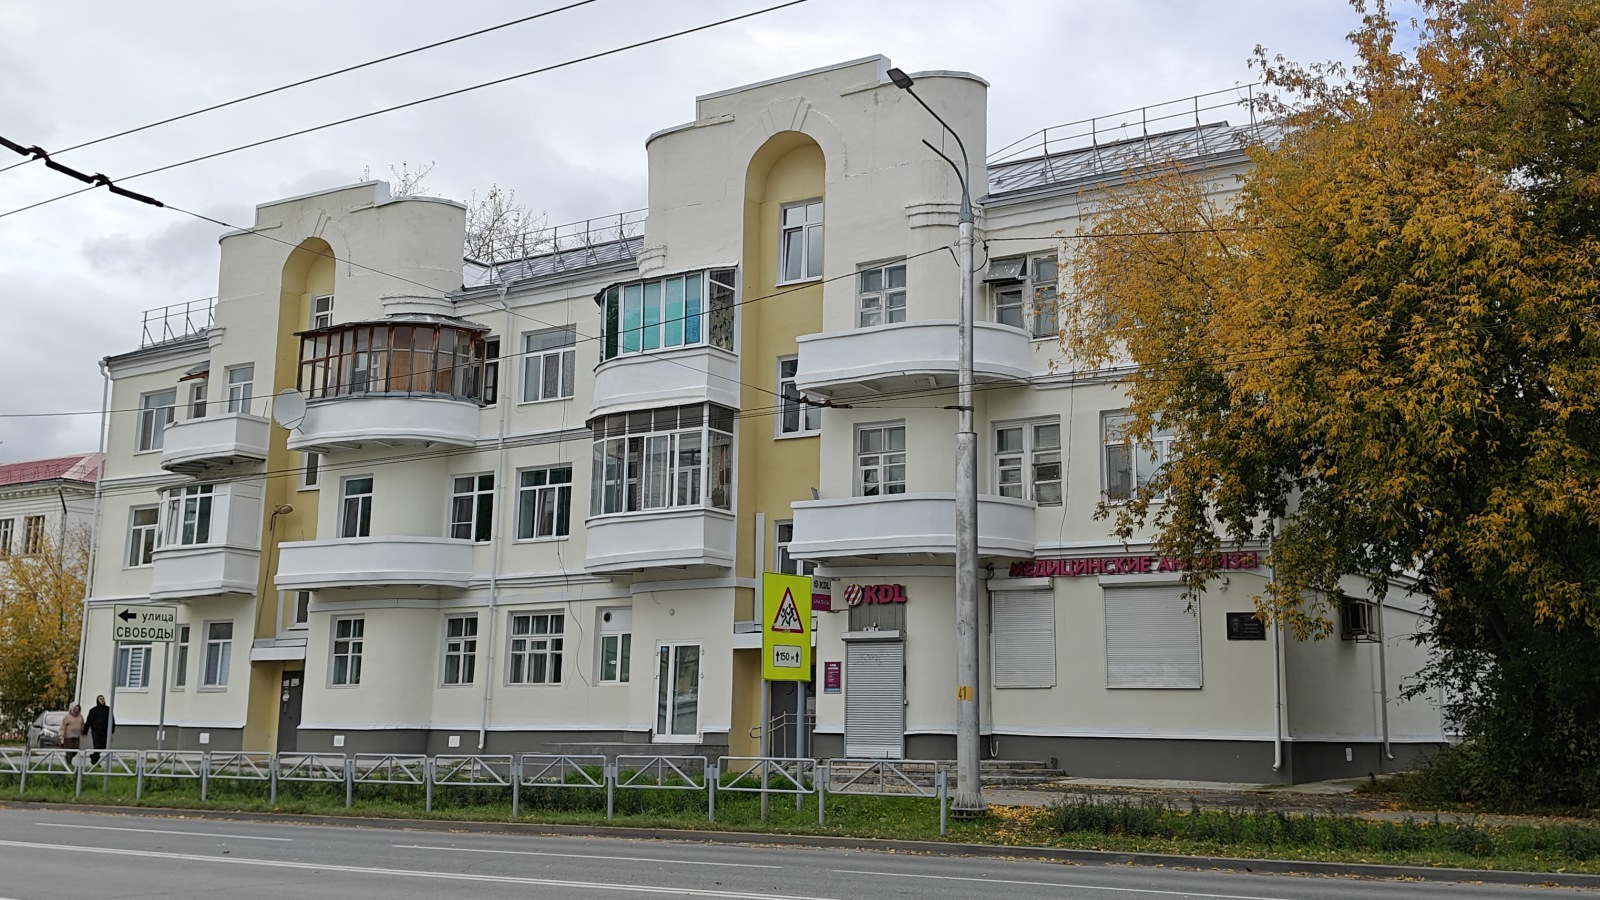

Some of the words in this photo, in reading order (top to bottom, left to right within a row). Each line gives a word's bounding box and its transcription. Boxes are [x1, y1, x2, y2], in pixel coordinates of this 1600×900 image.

[1008, 556, 1152, 577] МЕДИЦИНСКИЕ
[864, 583, 908, 604] KDL
[142, 613, 173, 623] улица
[116, 626, 174, 640] СВОБОДЫ
[780, 652, 789, 661] 150
[958, 685, 967, 700] 41
